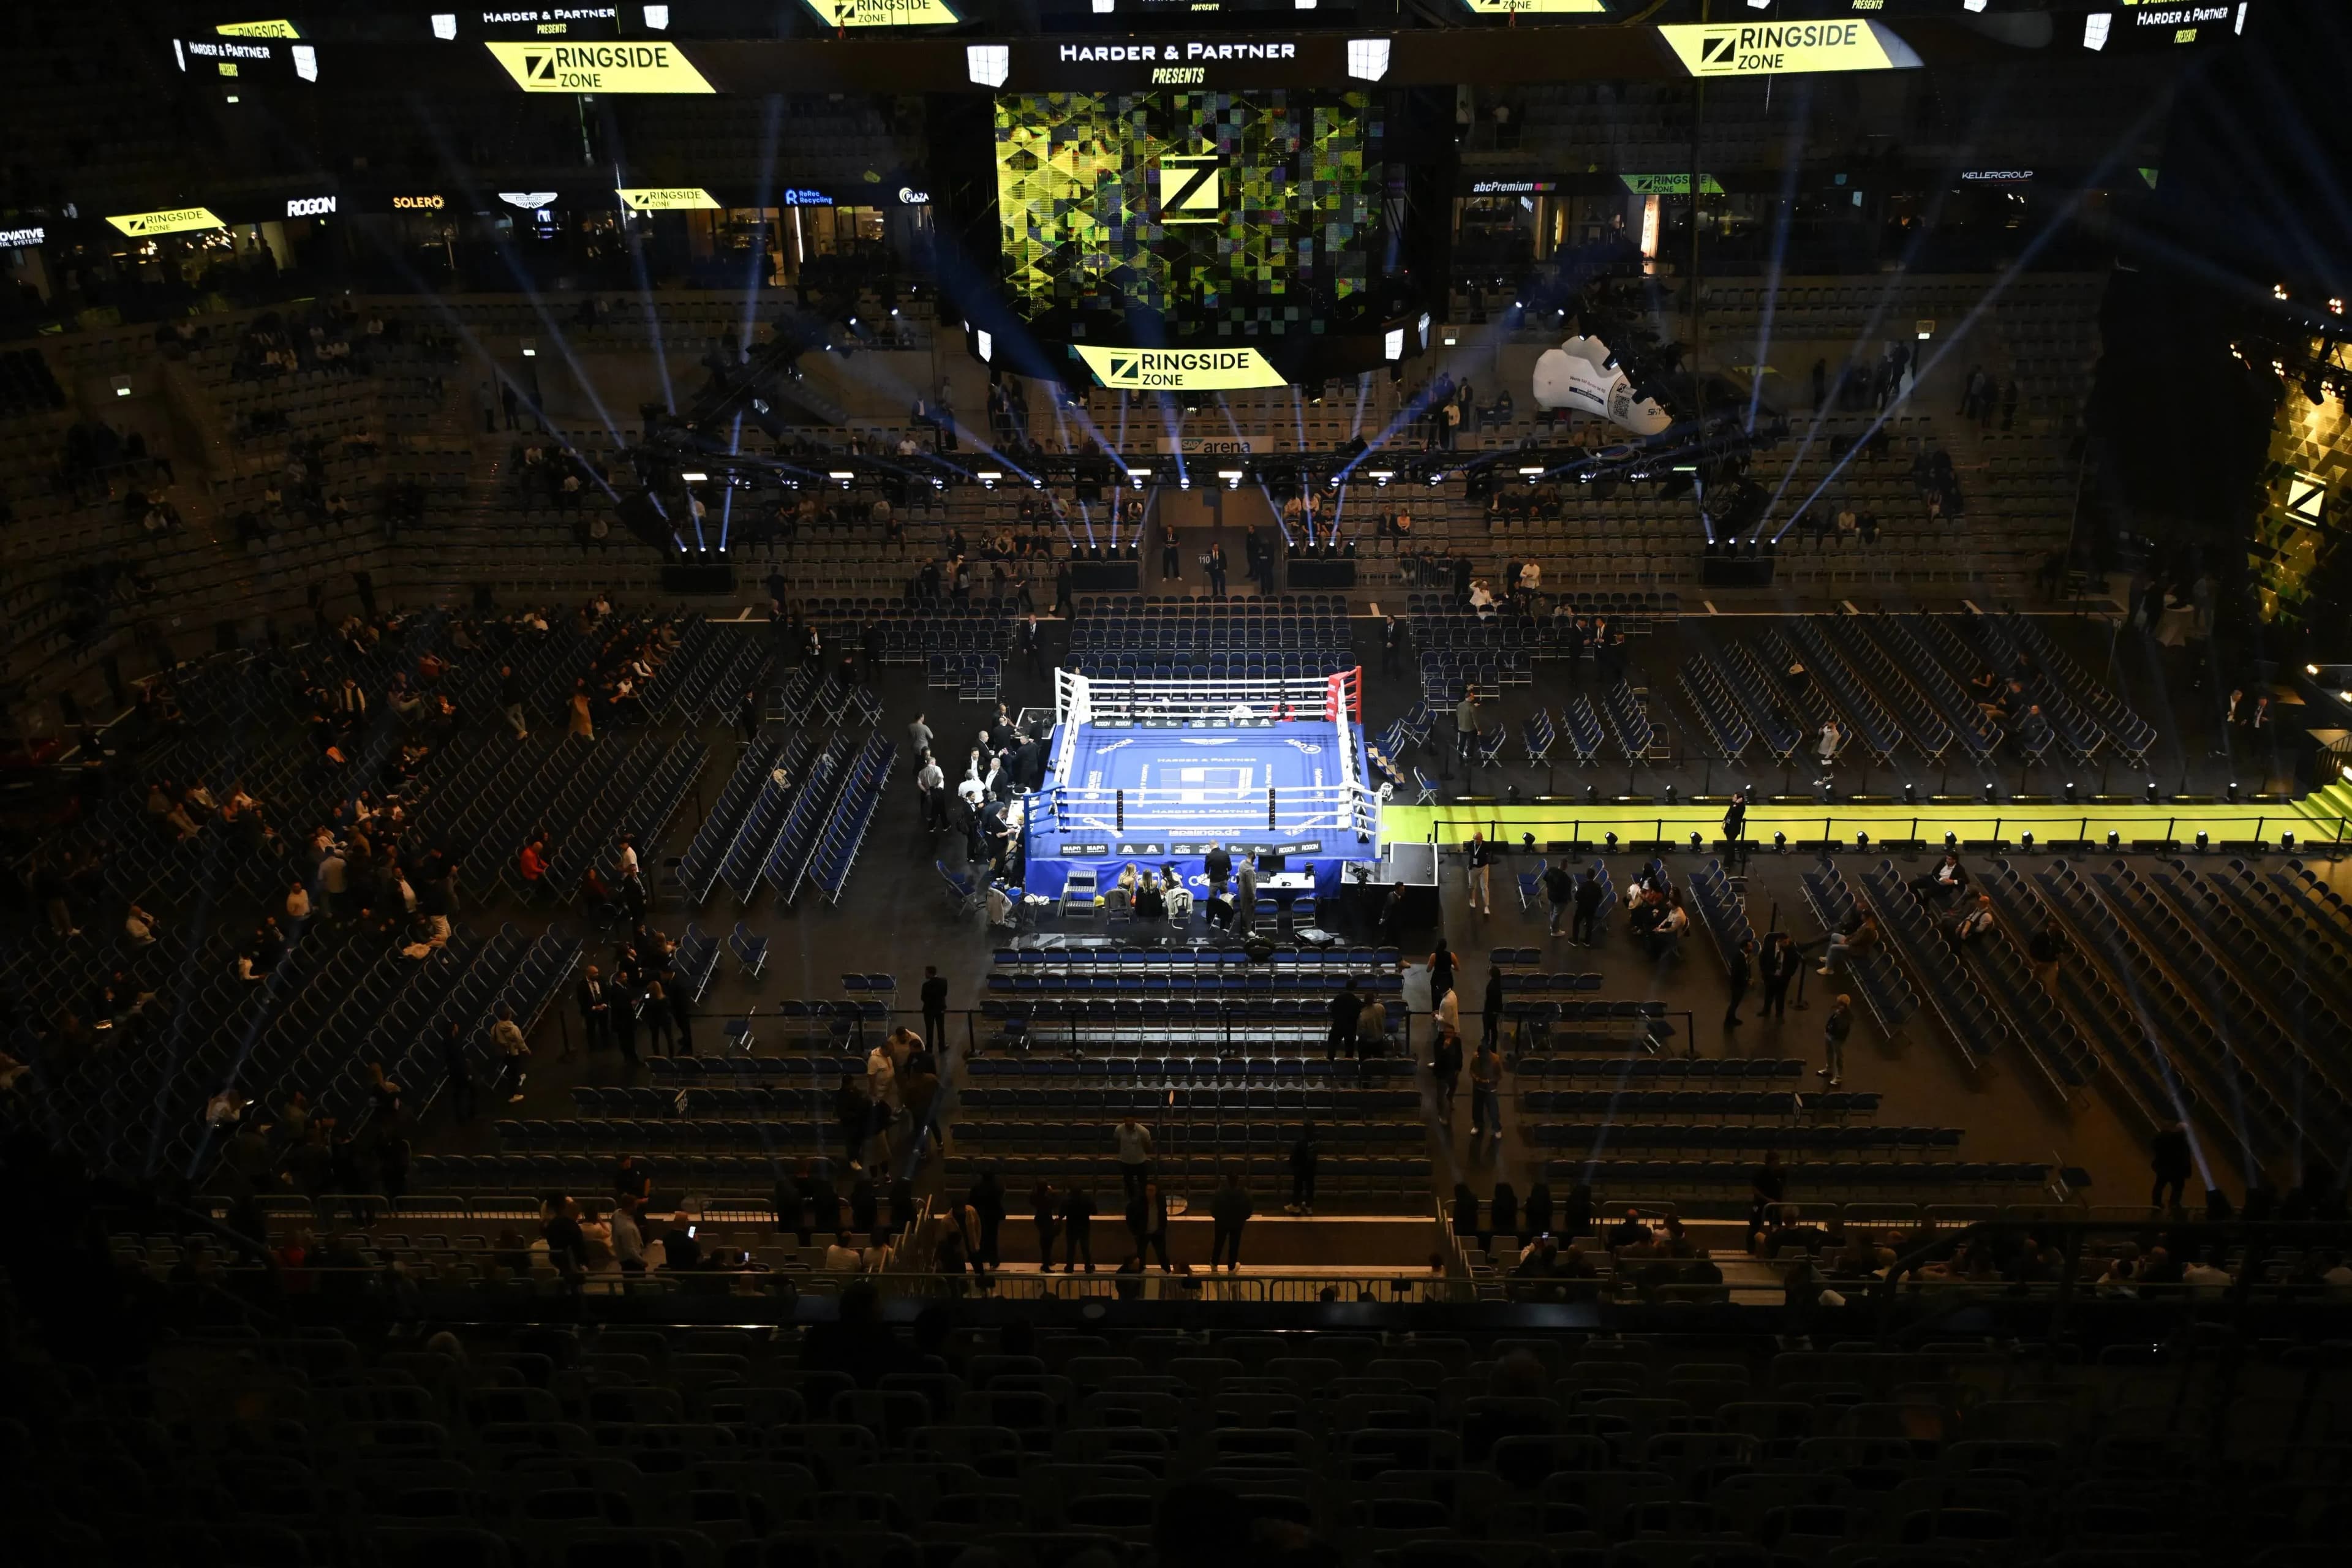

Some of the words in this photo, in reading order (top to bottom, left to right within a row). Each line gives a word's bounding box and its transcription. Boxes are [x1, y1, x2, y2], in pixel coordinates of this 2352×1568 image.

[1502, 1, 1532, 9] ZONE
[1852, 0, 1883, 9] PRESENTS
[483, 12, 538, 23] HARDER
[542, 11, 551, 20] &
[554, 9, 616, 20] PARTNER
[858, 14, 886, 23] ZONE
[2137, 12, 2182, 25] HARDER
[2184, 10, 2191, 22] &
[2193, 7, 2228, 21] PARTNER
[537, 23, 567, 34] PRESENTS
[2174, 28, 2197, 43] PRESENTS
[1740, 24, 1858, 50] RINGSIDE
[189, 42, 217, 56] HARDER
[219, 45, 225, 56] &
[225, 43, 271, 59] PARTNER
[556, 47, 669, 67] RINGSIDE
[1060, 45, 1156, 61] HARDER
[1164, 47, 1178, 59] &
[1188, 43, 1295, 59] PARTNER
[1738, 54, 1784, 69] ZONE
[560, 74, 602, 87] ZONE
[1152, 68, 1205, 84] PRESENTS
[1654, 176, 1706, 185] RINGSE
[1962, 170, 2033, 179] KELLERGROUP
[1473, 182, 1532, 192] abcPremium
[393, 194, 445, 209] SOLERO
[650, 190, 701, 200] RINGSIDE
[287, 196, 336, 217] ROGON
[146, 210, 203, 225] RINGSIDE
[1142, 353, 1250, 370] RINGSIDE
[1142, 374, 1184, 386] ZONE
[1182, 440, 1199, 449] SAP
[1204, 441, 1250, 453] arena
[1198, 556, 1210, 564] 110
